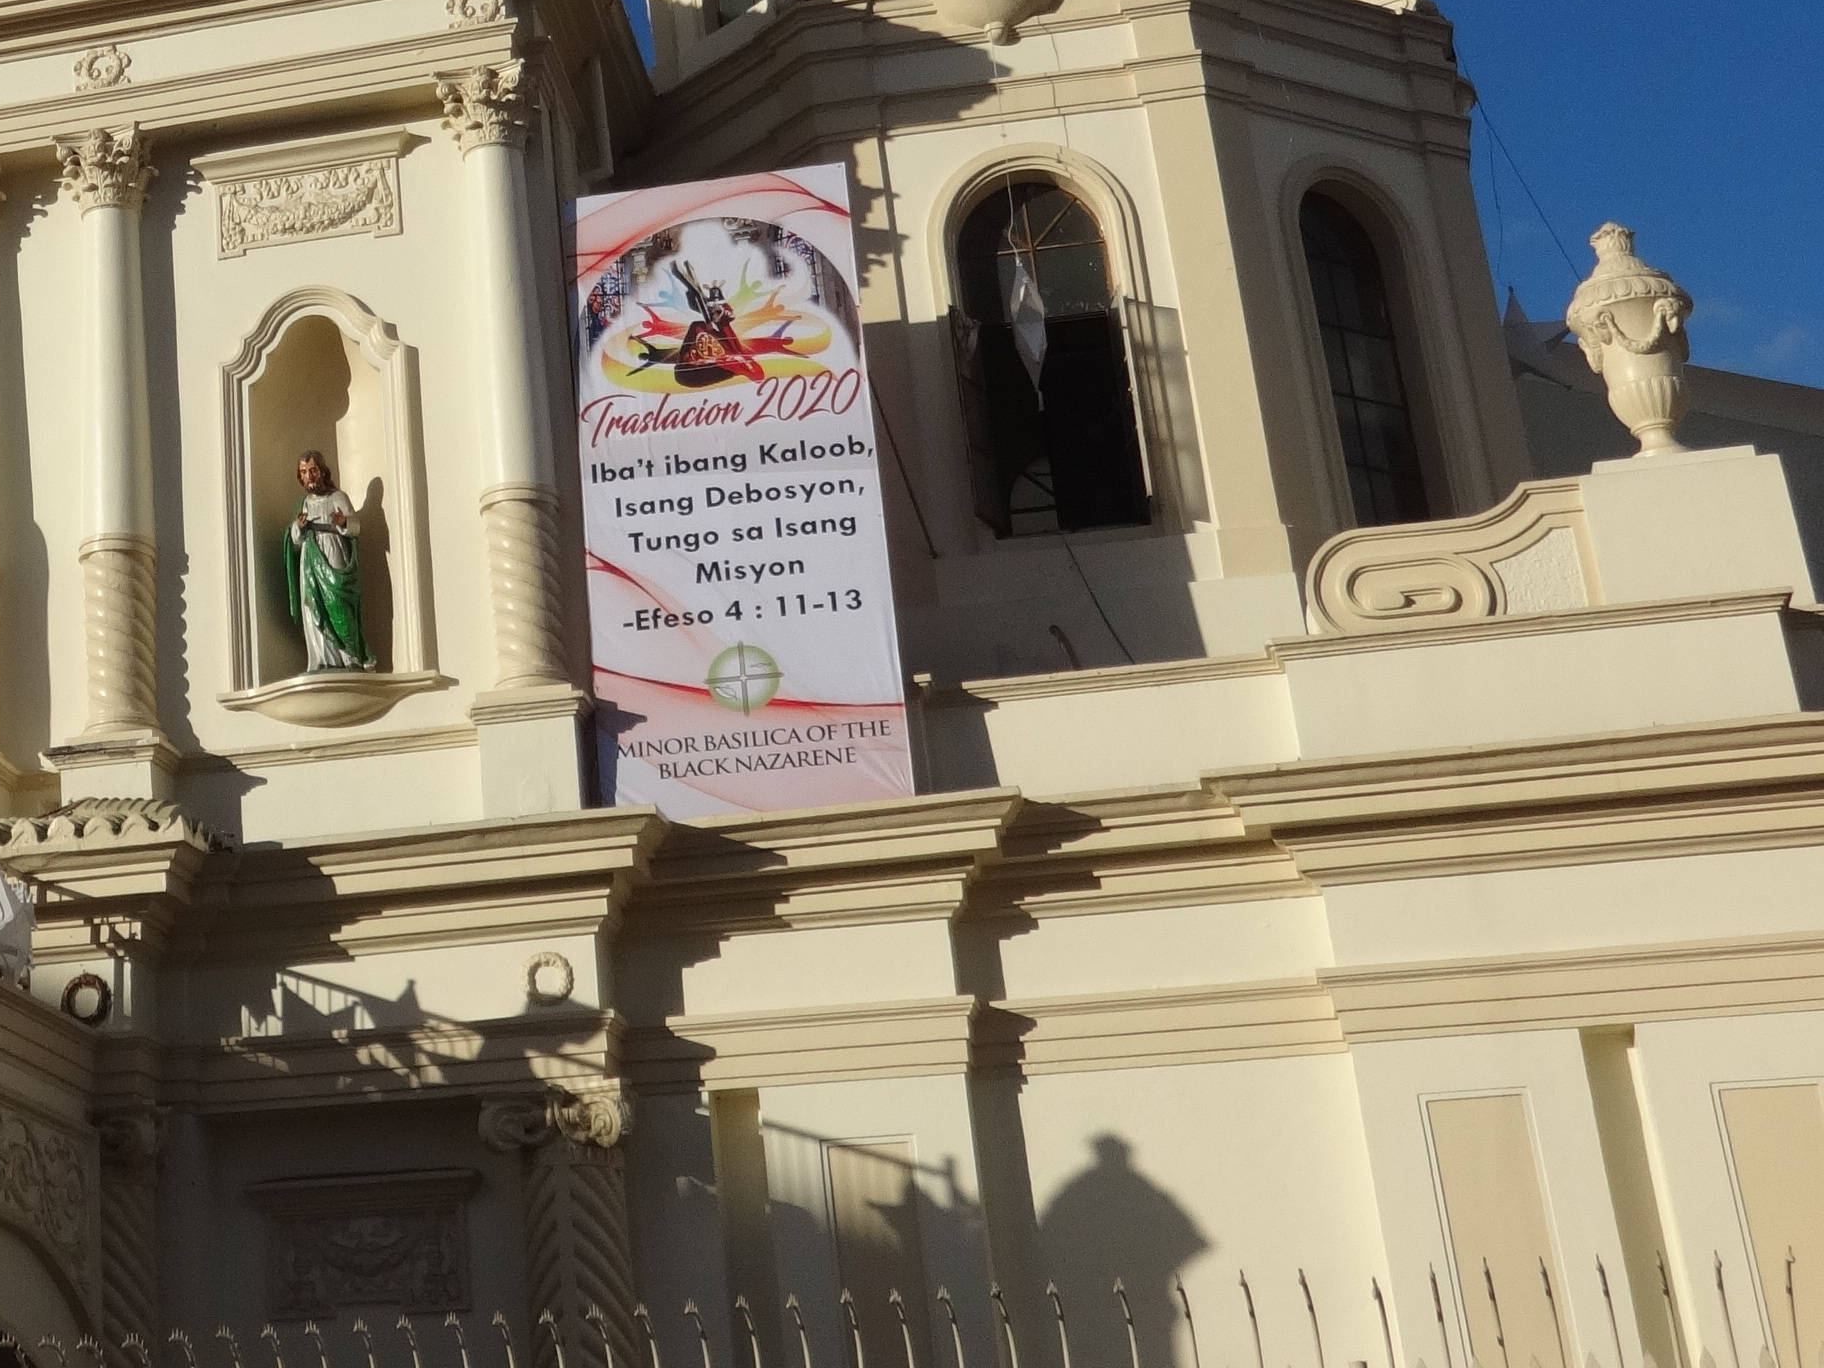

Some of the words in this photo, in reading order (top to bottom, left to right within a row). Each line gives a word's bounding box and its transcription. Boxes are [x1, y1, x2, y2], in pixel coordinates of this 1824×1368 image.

[581, 393, 743, 448] Traslacion
[745, 368, 861, 427] 2020
[591, 457, 655, 484] Iba't
[665, 452, 747, 476] ibang
[759, 435, 874, 465] Kaloob,
[616, 495, 694, 518] Isang
[705, 478, 865, 508] Debosyon,
[628, 530, 719, 553] Tungo
[731, 525, 763, 542] sa
[776, 515, 857, 538] Isang
[696, 559, 805, 584] Misyon
[623, 608, 714, 631] -Efeso
[725, 600, 743, 622] 4
[776, 589, 863, 617] 11-13
[617, 736, 698, 759] MINOR
[704, 728, 803, 752] BASILICA
[806, 724, 839, 743] OF
[841, 719, 892, 739] THE
[657, 757, 731, 780] BLACK
[735, 746, 857, 774] NAZARENE
